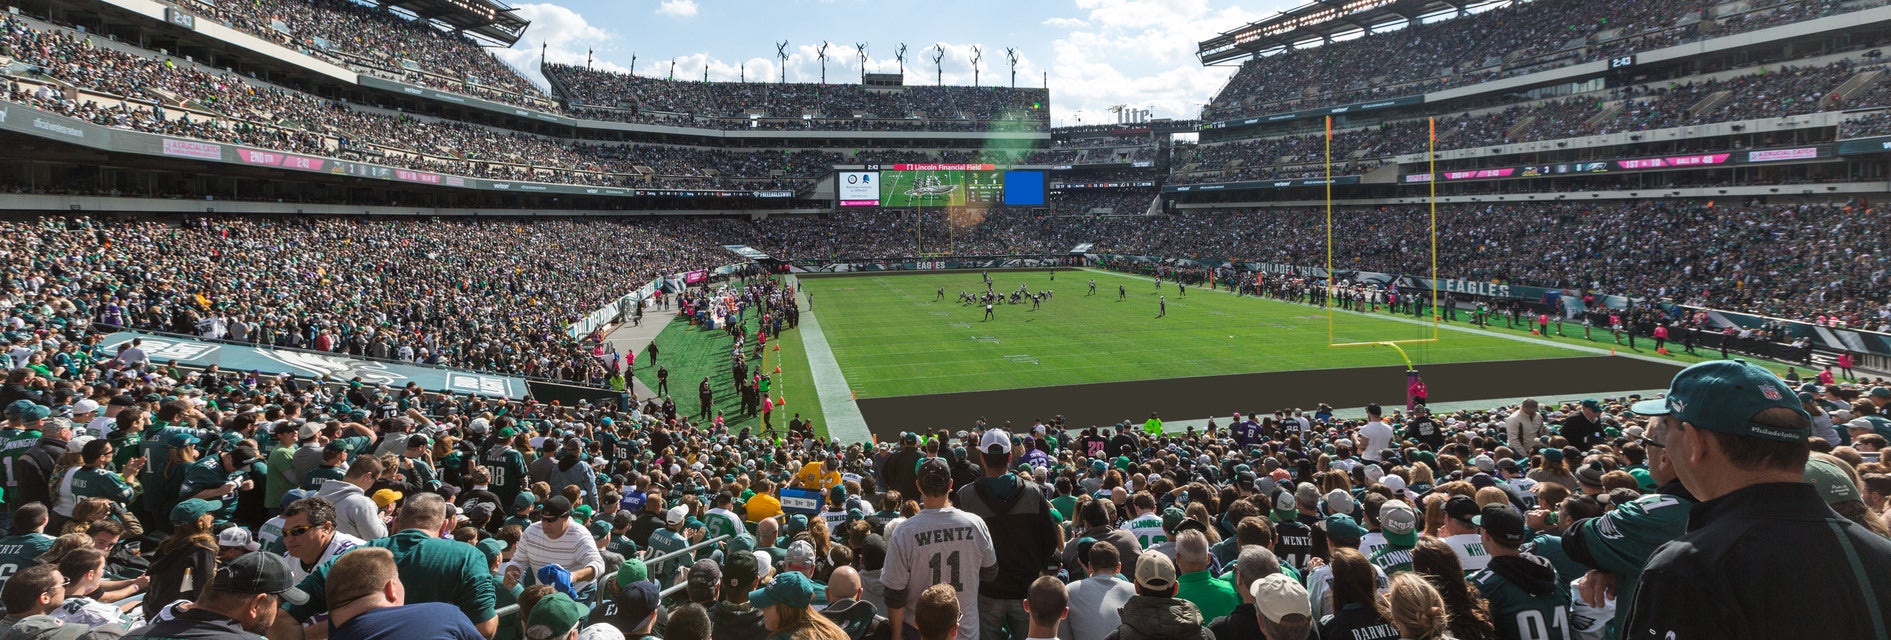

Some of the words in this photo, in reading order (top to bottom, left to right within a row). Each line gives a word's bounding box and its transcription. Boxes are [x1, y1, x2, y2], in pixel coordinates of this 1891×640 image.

[174, 10, 192, 27] 2:43
[1612, 56, 1631, 67] 2:43
[250, 151, 264, 163] 2ND
[916, 261, 946, 270] EAGES
[1256, 262, 1318, 277] PHILADELHIA
[1446, 278, 1510, 298] EAGLES
[1247, 428, 1255, 438] 8
[1751, 426, 1800, 440] Philadelphia
[1088, 440, 1104, 457] 20
[1388, 519, 1416, 531] EAGLES
[914, 526, 974, 547] WENTZ
[928, 550, 964, 593] 11
